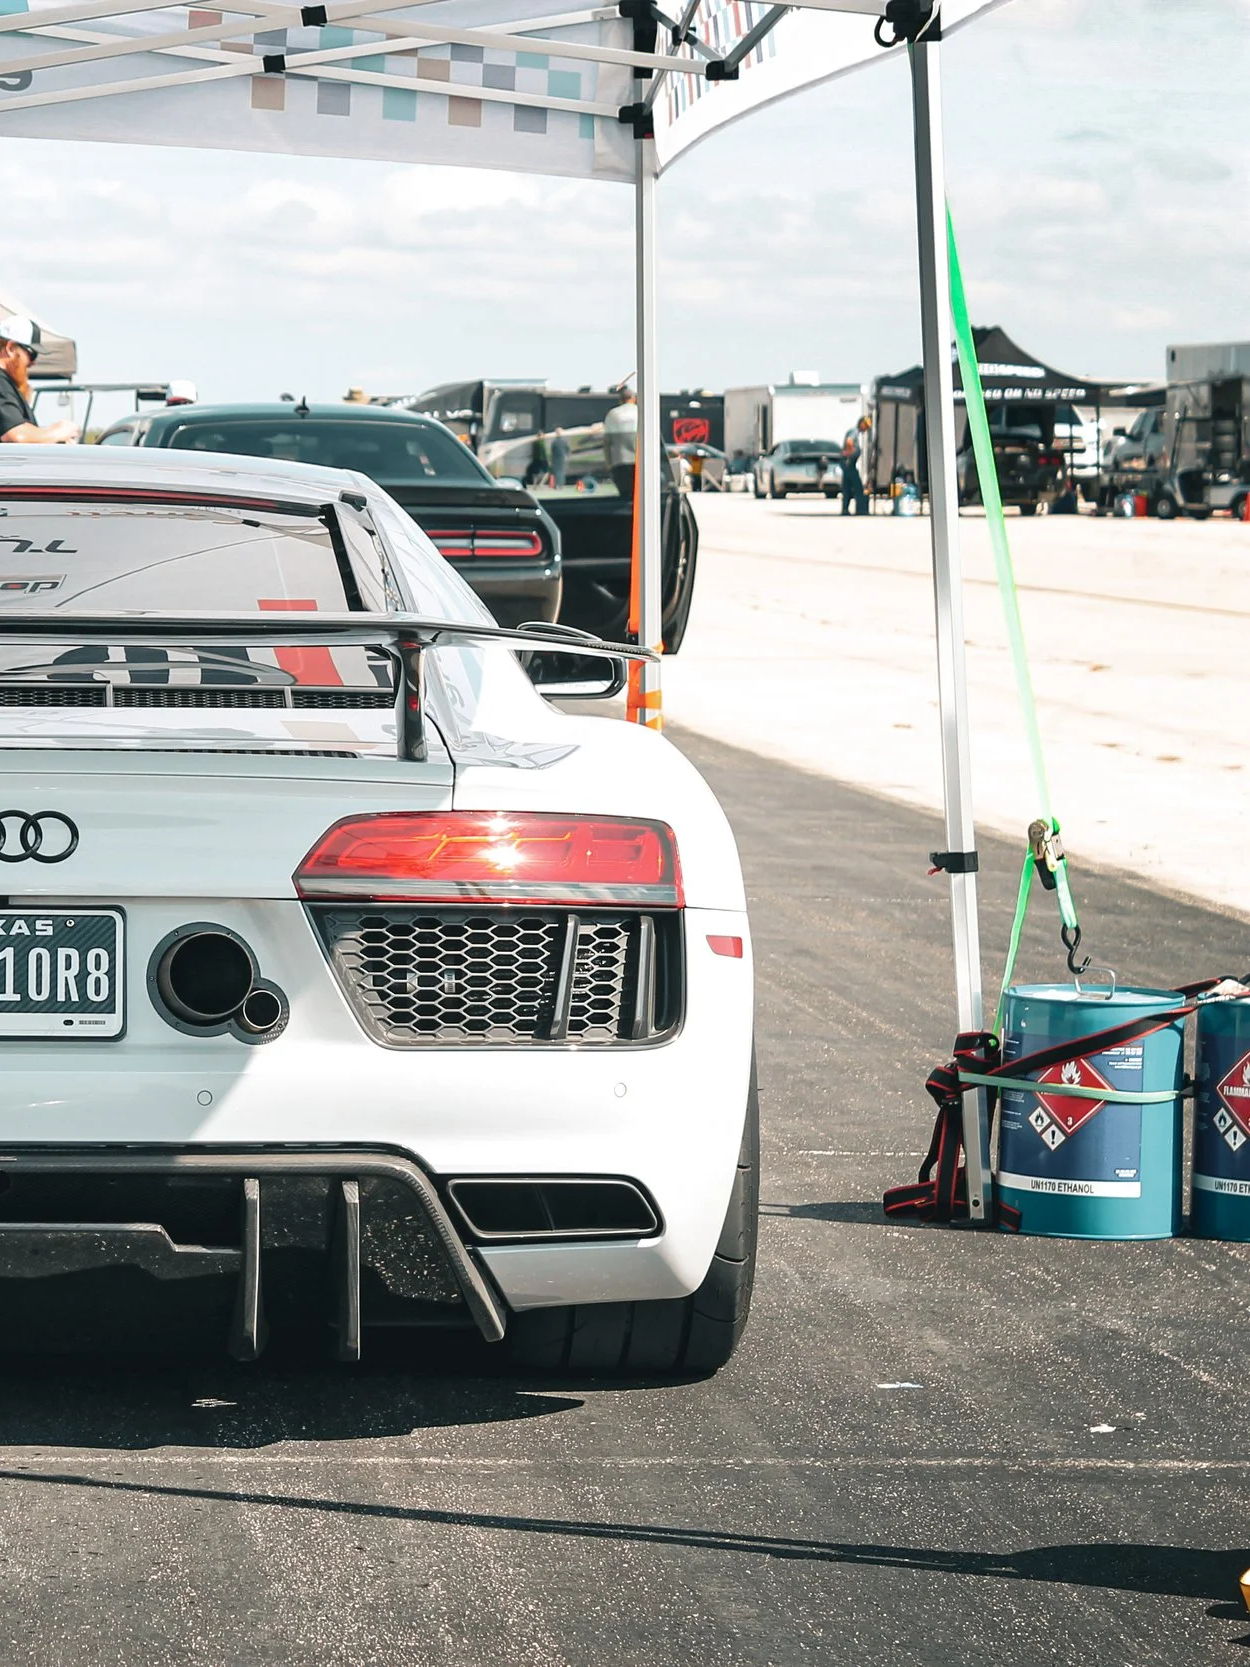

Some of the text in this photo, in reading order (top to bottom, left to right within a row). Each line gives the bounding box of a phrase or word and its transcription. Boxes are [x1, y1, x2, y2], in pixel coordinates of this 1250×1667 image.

[1067, 1116, 1073, 1126] 3
[1031, 1180, 1095, 1193] UN1170 ETHANOL
[1215, 1181, 1238, 1193] UN1170
